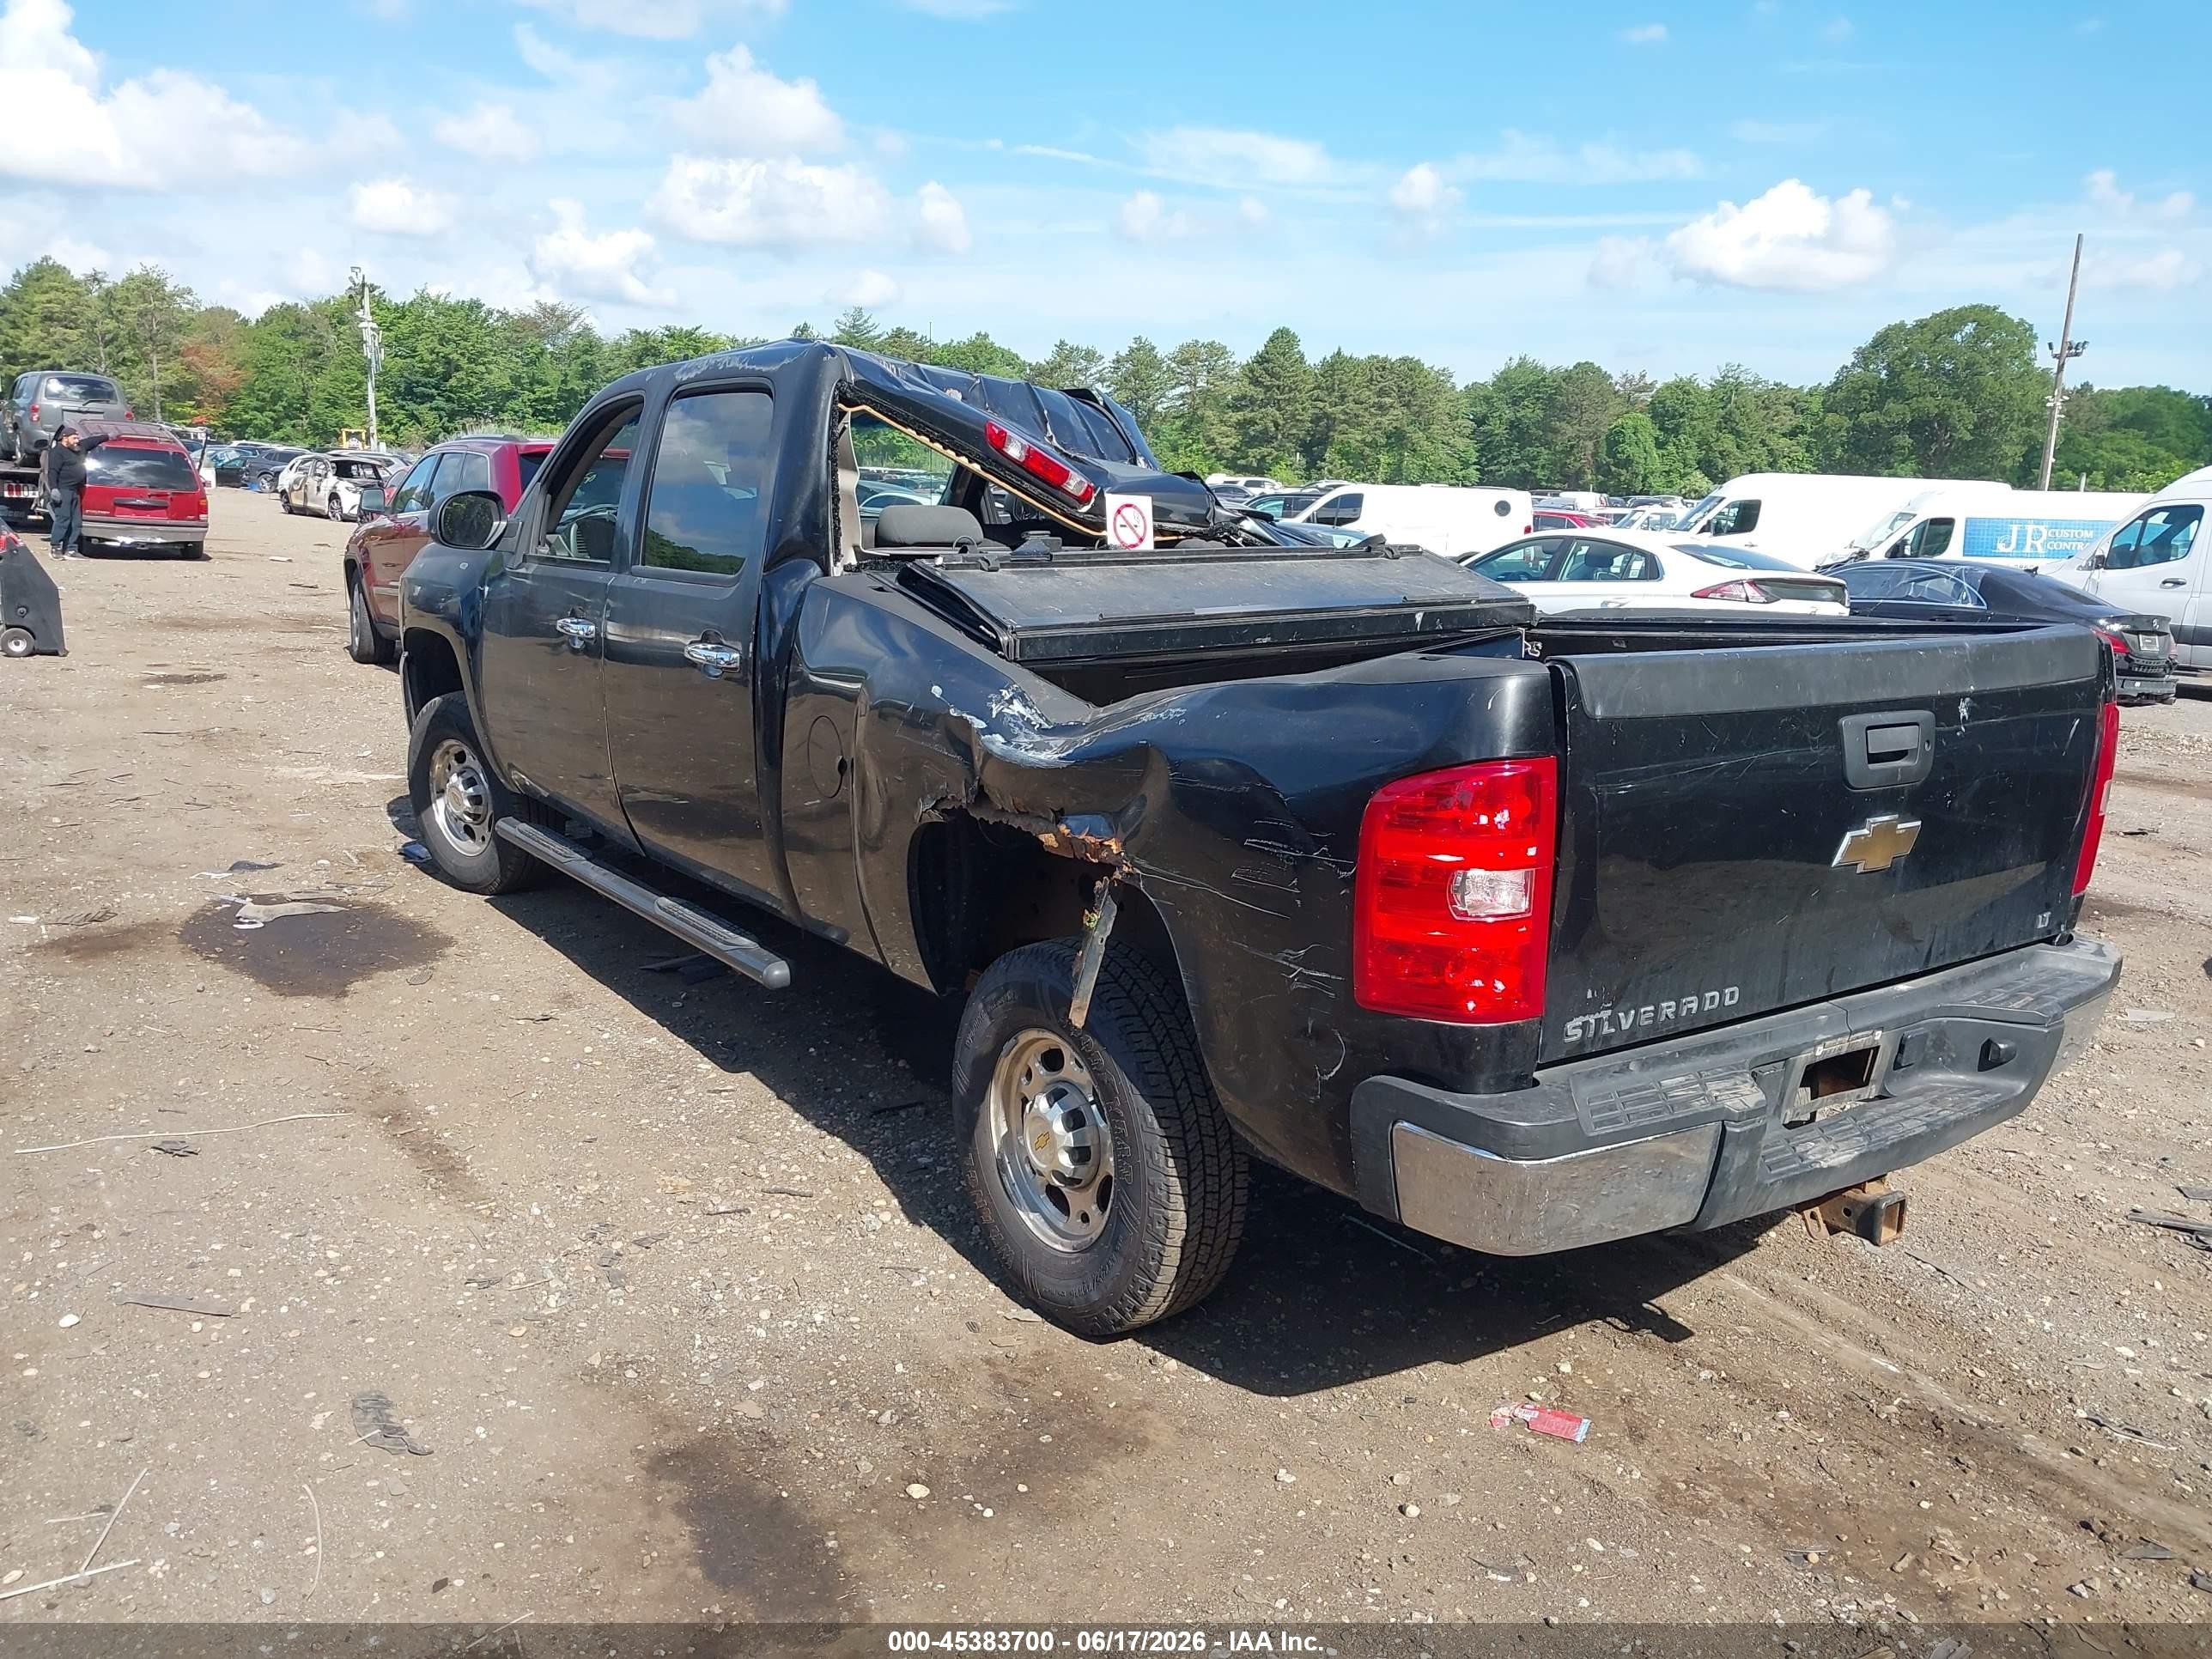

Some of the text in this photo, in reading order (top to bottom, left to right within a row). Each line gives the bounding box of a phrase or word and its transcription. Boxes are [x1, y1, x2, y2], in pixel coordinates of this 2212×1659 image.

[2047, 528, 2094, 538] CUSTOM
[2037, 911, 2051, 929] LT
[1563, 986, 1740, 1043] SILVERADO
